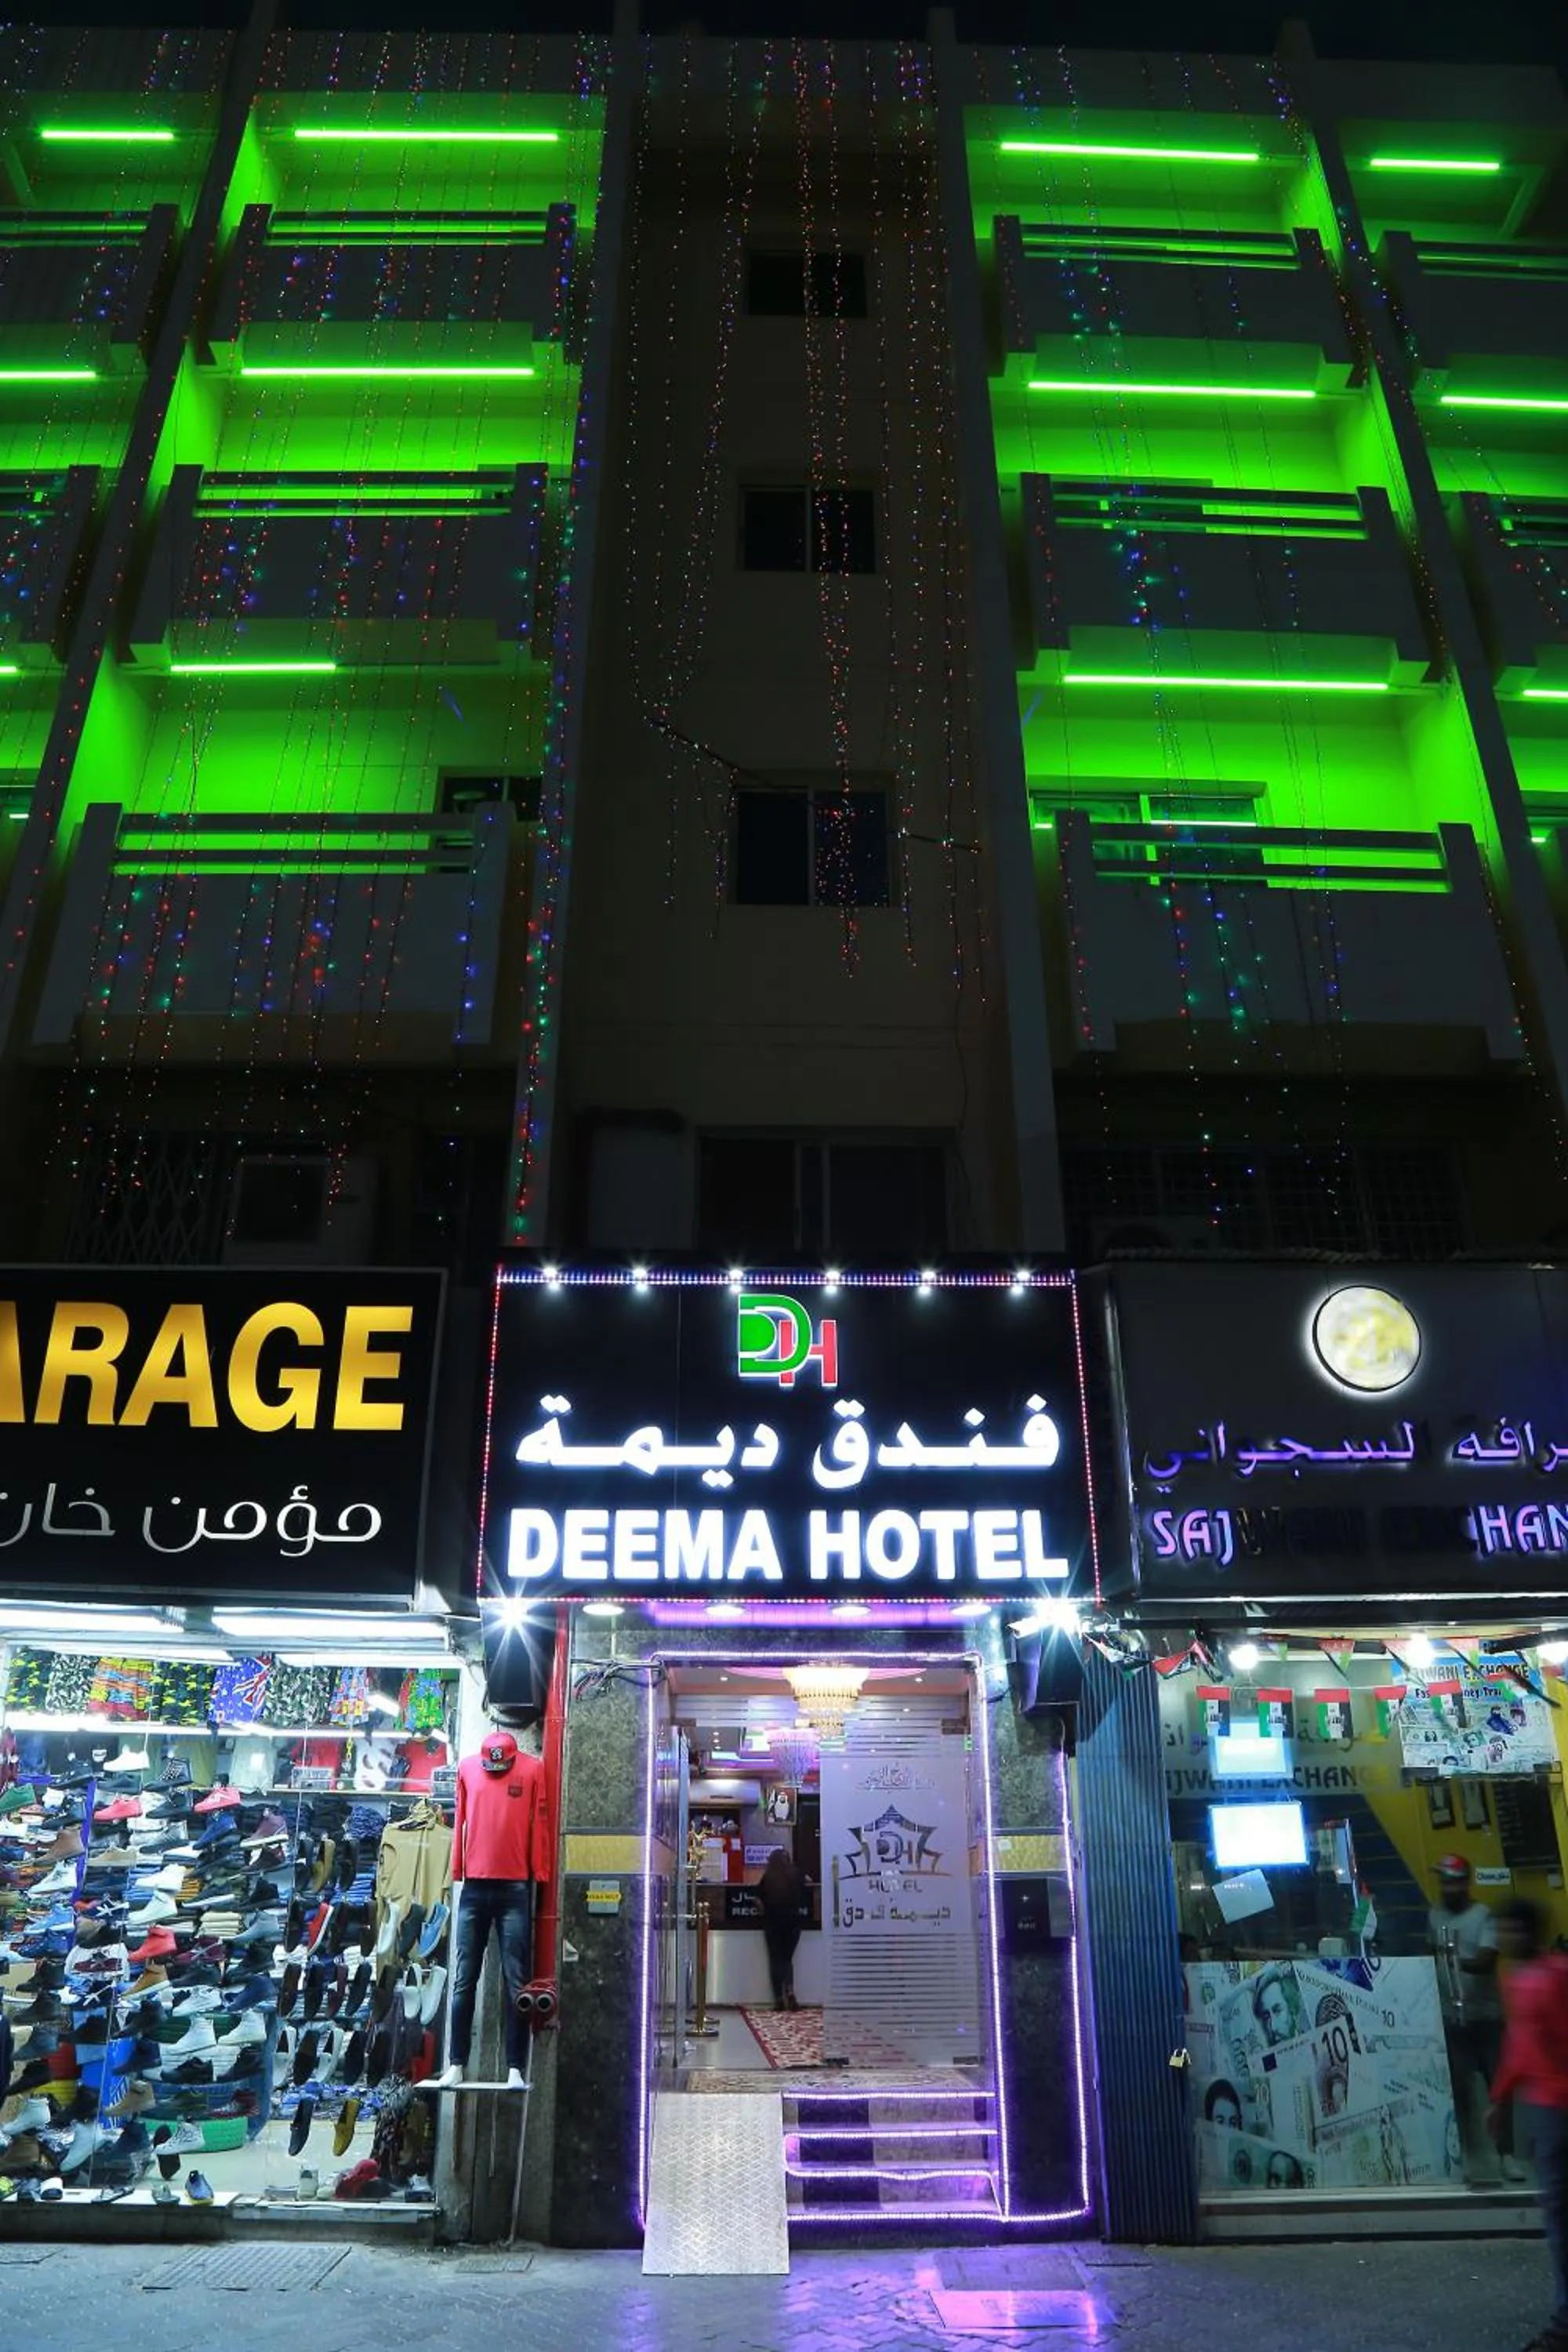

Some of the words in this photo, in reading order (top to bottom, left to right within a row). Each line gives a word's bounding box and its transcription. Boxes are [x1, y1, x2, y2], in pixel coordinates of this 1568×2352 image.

[0, 1301, 413, 1432] RAGE
[515, 1394, 780, 1488] ديمة
[812, 1393, 1061, 1490] فندق
[142, 1485, 383, 1556] مؤمن
[506, 1508, 783, 1581] DEEMA
[809, 1509, 1069, 1581] HOTEL
